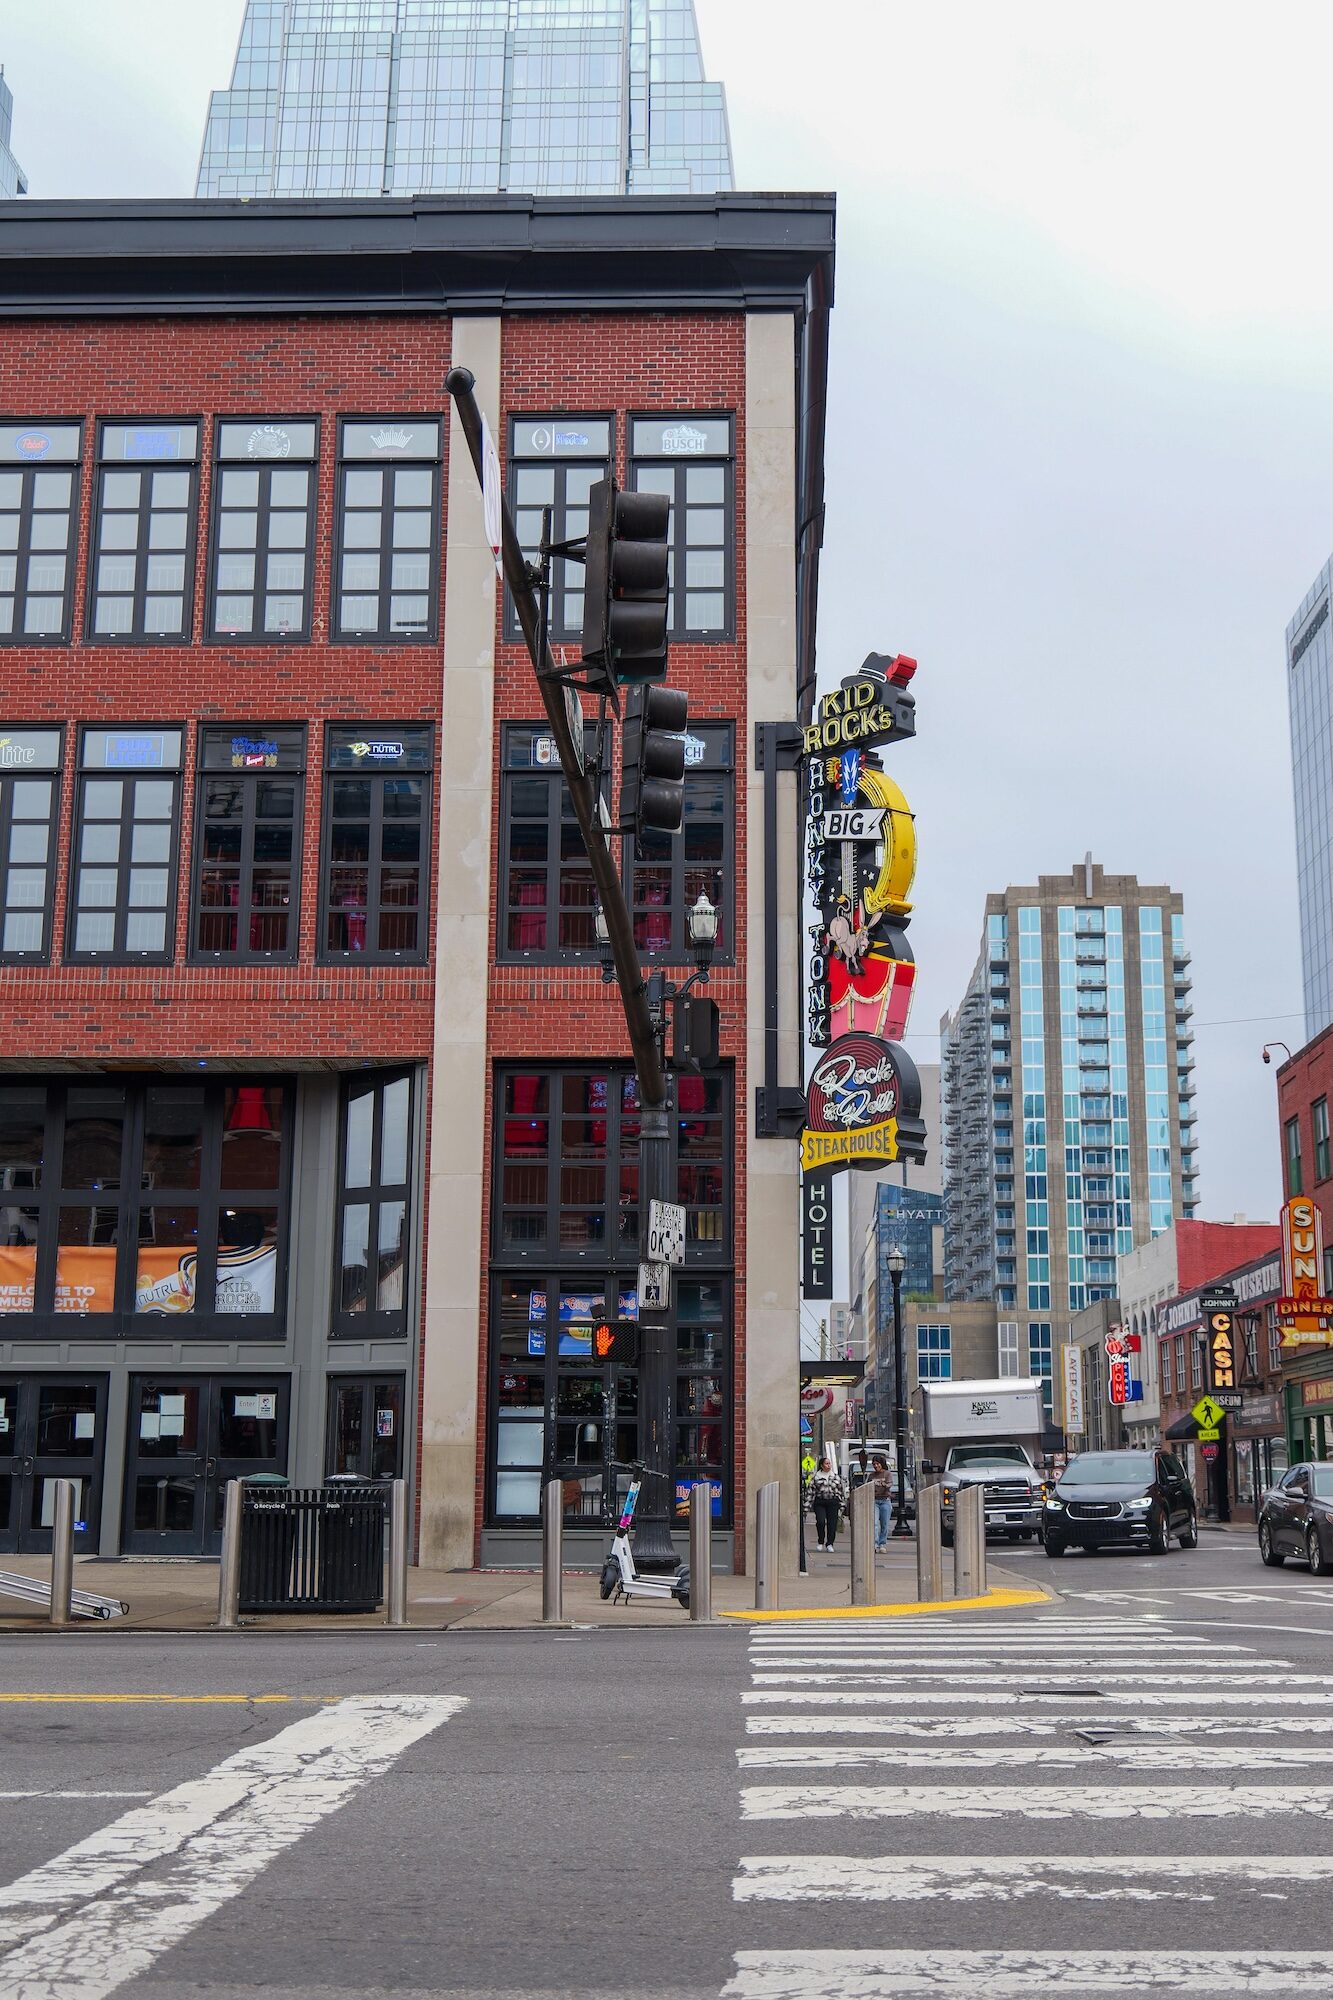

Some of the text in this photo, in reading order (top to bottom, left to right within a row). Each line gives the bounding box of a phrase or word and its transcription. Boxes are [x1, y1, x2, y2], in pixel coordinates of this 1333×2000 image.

[247, 427, 264, 453] WHITE
[263, 425, 288, 439] CLAW
[664, 438, 704, 450] BUSCH
[822, 681, 875, 718] KID
[231, 736, 278, 755] Coors
[809, 762, 826, 906] HONKY
[829, 812, 864, 836] BIG
[809, 924, 826, 1043] TONK
[814, 1055, 895, 1098] Rock
[836, 1090, 896, 1125] Roll
[807, 1126, 891, 1162] STEAKHOUSE
[655, 1203, 681, 1220] DIAGONAL
[655, 1215, 681, 1232] CROSSING
[896, 1210, 943, 1220] HYATT
[650, 1231, 664, 1254] OK
[808, 1184, 827, 1286] HOTEL
[1293, 1205, 1316, 1279] SUN
[224, 1282, 252, 1293] KID
[645, 1271, 662, 1280] ONLY
[1232, 1261, 1281, 1303] MUSEUM
[74, 1286, 96, 1296] TO
[1202, 1299, 1237, 1307] JOHNNY
[1280, 1300, 1333, 1314] DINER
[1211, 1313, 1234, 1387] CASH
[1292, 1332, 1327, 1341] OPEN
[1069, 1350, 1077, 1388] LAYER
[1114, 1364, 1123, 1401] PONY
[1070, 1389, 1079, 1422] CAKE
